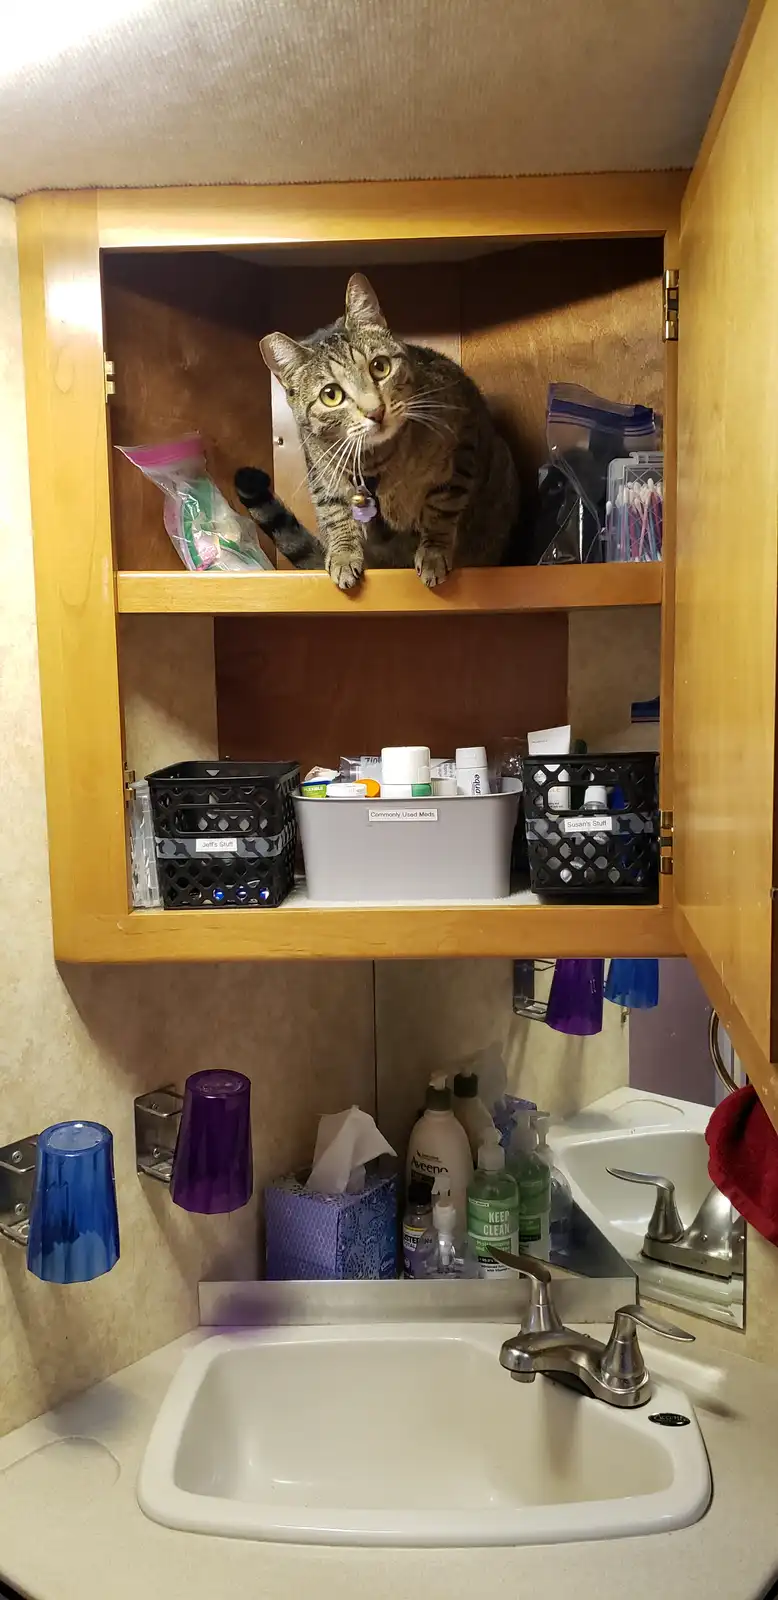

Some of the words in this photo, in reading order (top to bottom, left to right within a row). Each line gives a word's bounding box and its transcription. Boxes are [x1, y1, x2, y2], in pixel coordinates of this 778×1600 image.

[473, 774, 482, 796] equa
[567, 820, 591, 828] Susan's
[488, 1210, 510, 1223] KEEP
[483, 1223, 511, 1236] CLEAN
